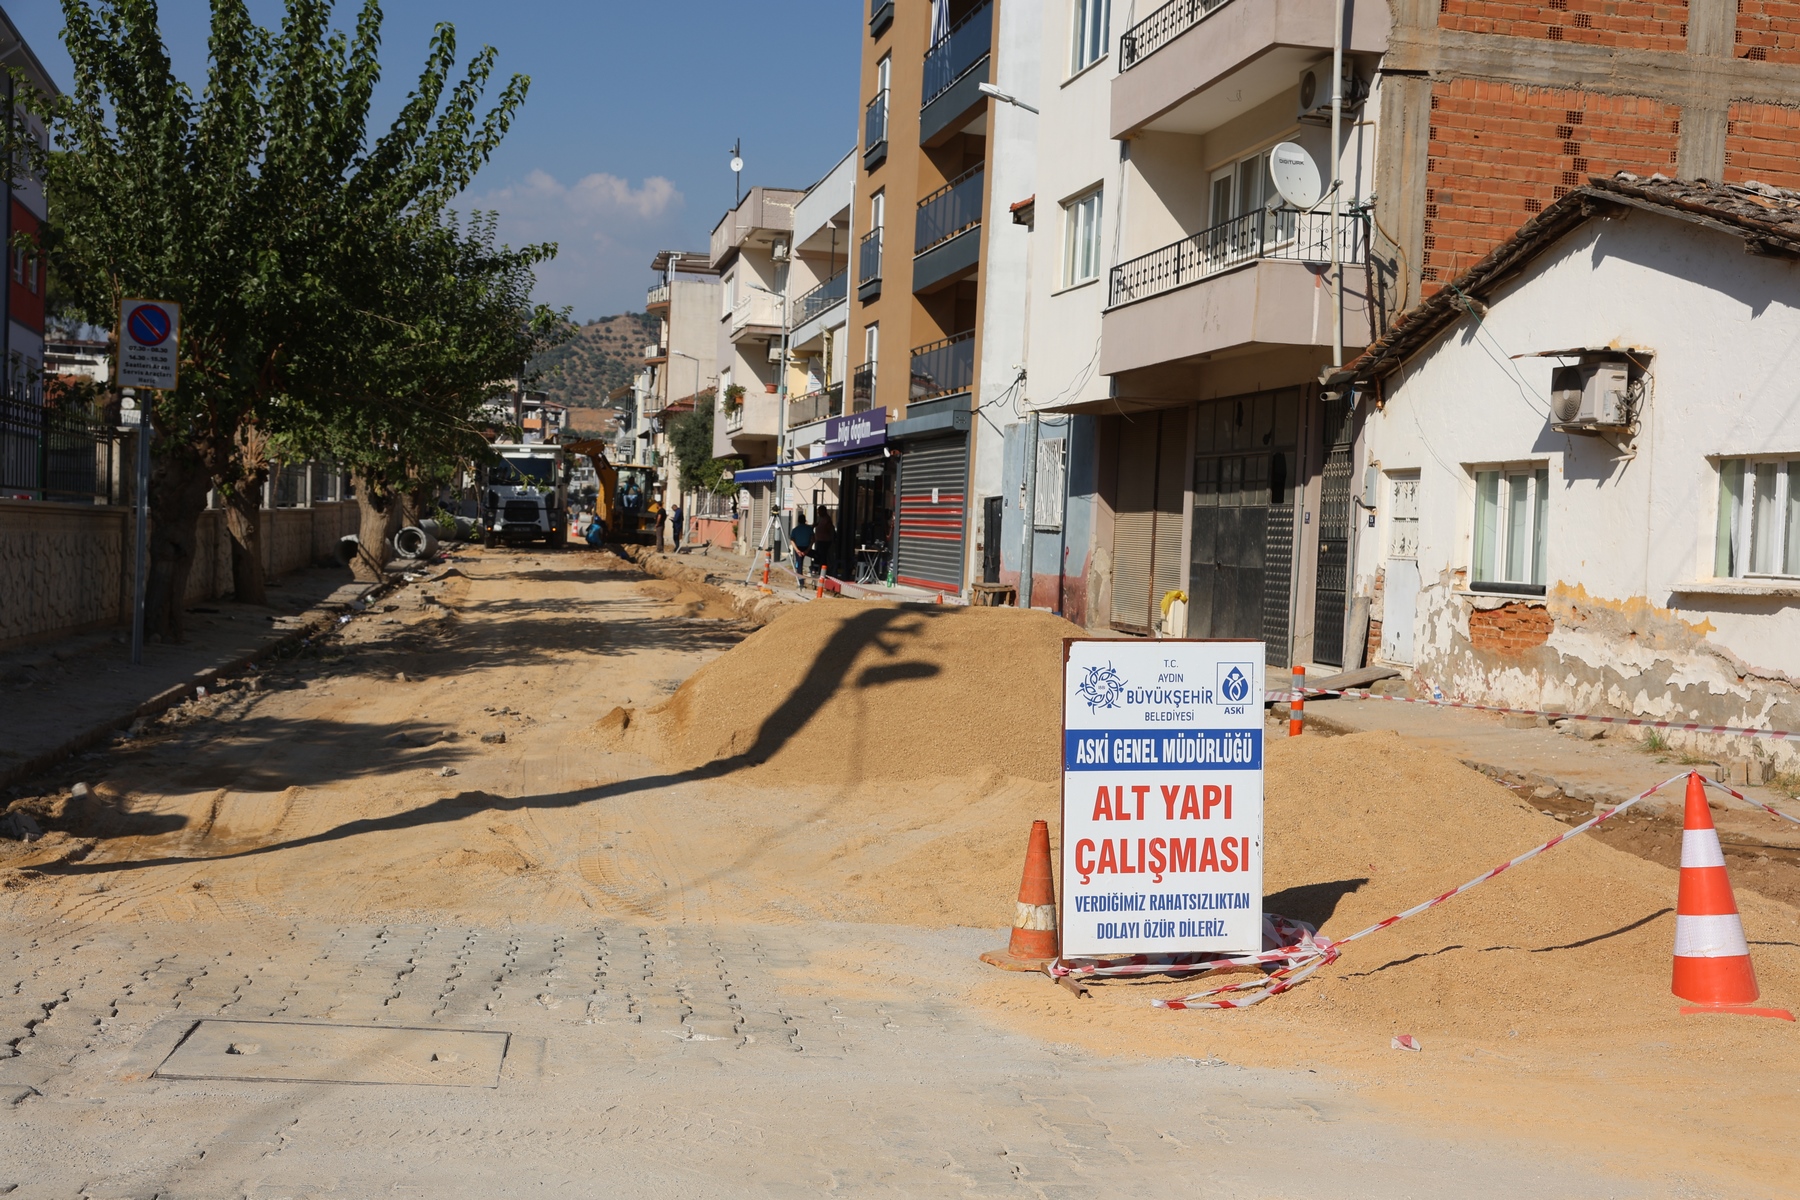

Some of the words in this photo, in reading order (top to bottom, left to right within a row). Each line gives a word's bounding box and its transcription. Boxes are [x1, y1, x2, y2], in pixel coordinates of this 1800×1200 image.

[838, 421, 850, 446] bilgi
[1163, 659, 1179, 668] T.C.
[1157, 673, 1184, 683] AYDIN
[1126, 686, 1213, 708] BÜYÜKŞEHİR
[1144, 712, 1195, 722] BELEDİYESİ
[1224, 705, 1244, 715] ASKİ
[1076, 733, 1109, 764] ASKİ
[1113, 738, 1158, 764] GENEL
[1162, 732, 1253, 764] MÜDÜRLÜĞÜ
[1092, 785, 1150, 821] ALT
[1160, 784, 1233, 820] YAPI
[1075, 836, 1250, 885] ÇALIŞMASI
[1075, 892, 1146, 913] VERDİĞİMİZ
[1149, 892, 1250, 911] RAHATSIZLIKTAN
[1096, 920, 1140, 940] DOLAYI
[1143, 919, 1175, 938] ÖZÜR
[1179, 917, 1229, 938] DİLERİZ.
